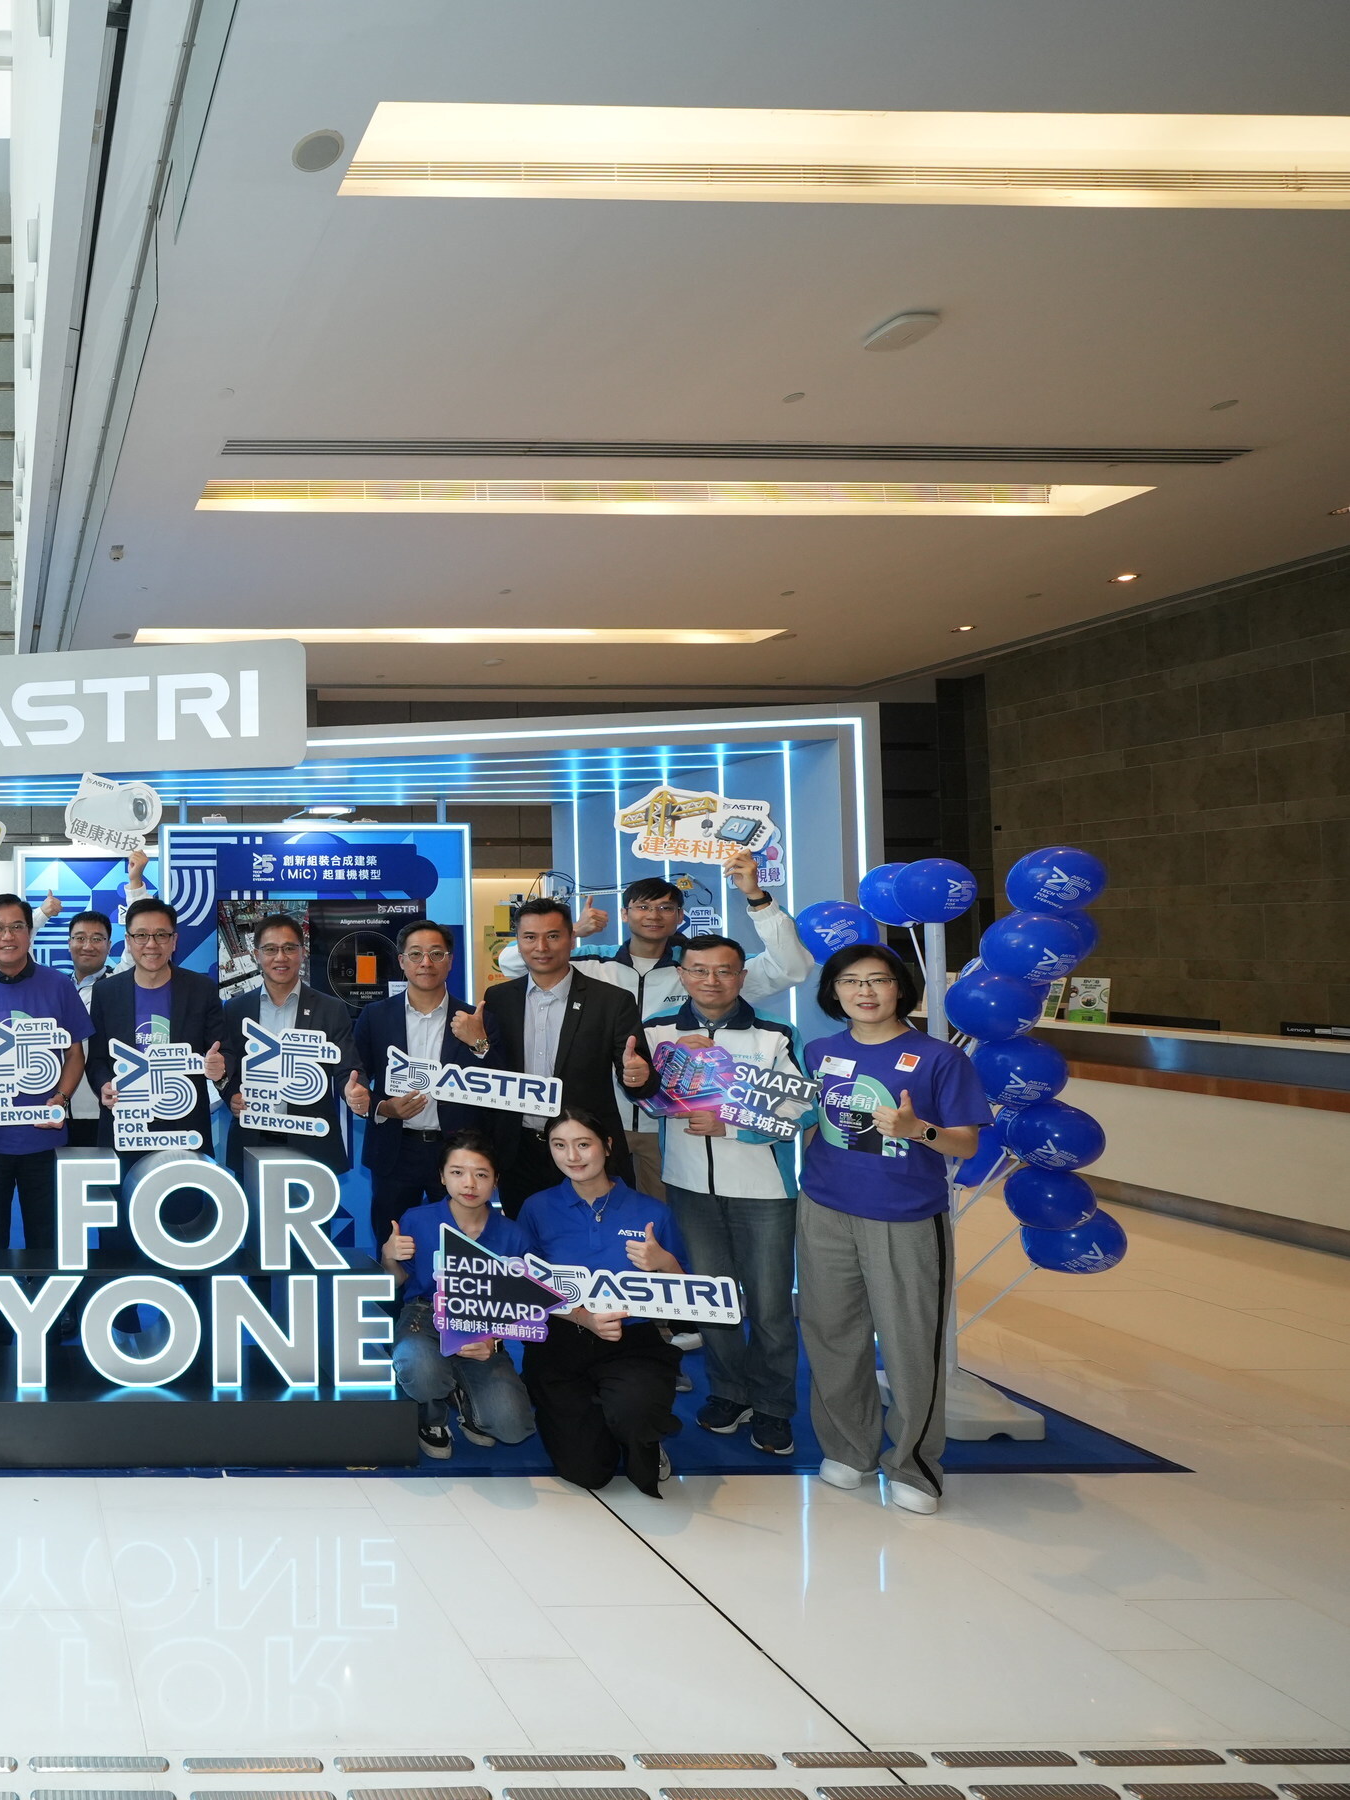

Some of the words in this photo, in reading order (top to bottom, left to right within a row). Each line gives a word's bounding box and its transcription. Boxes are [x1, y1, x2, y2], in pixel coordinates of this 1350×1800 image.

[91, 780, 114, 790] ASTRI
[70, 818, 141, 852] 健康科技
[727, 821, 748, 834] AI
[642, 837, 742, 860] 建築科技
[283, 855, 378, 866] 創新組裝合成建築
[1036, 891, 1048, 899] FOR
[1039, 887, 1055, 896] TECH
[15, 1022, 53, 1031] ASTRI
[281, 1032, 322, 1044] ASTRI
[149, 1047, 188, 1057] ASTRI
[436, 1068, 558, 1104] ASTRI
[733, 1065, 818, 1098] SMART
[244, 1088, 277, 1100] TECH
[727, 1085, 781, 1111] CITY
[116, 1109, 150, 1119] TECH
[719, 1103, 796, 1138] 智慧城市
[118, 1123, 144, 1133] FOR
[244, 1114, 313, 1131] EVERYONE
[119, 1136, 187, 1147] EVERYONE
[56, 1159, 351, 1271] FOR
[618, 1229, 646, 1238] ASTR
[438, 1255, 525, 1277] LEADING
[437, 1276, 491, 1296] TECH
[588, 1275, 733, 1308] ASTRI
[437, 1296, 546, 1322] FORWARD
[437, 1316, 489, 1334] 引領創科
